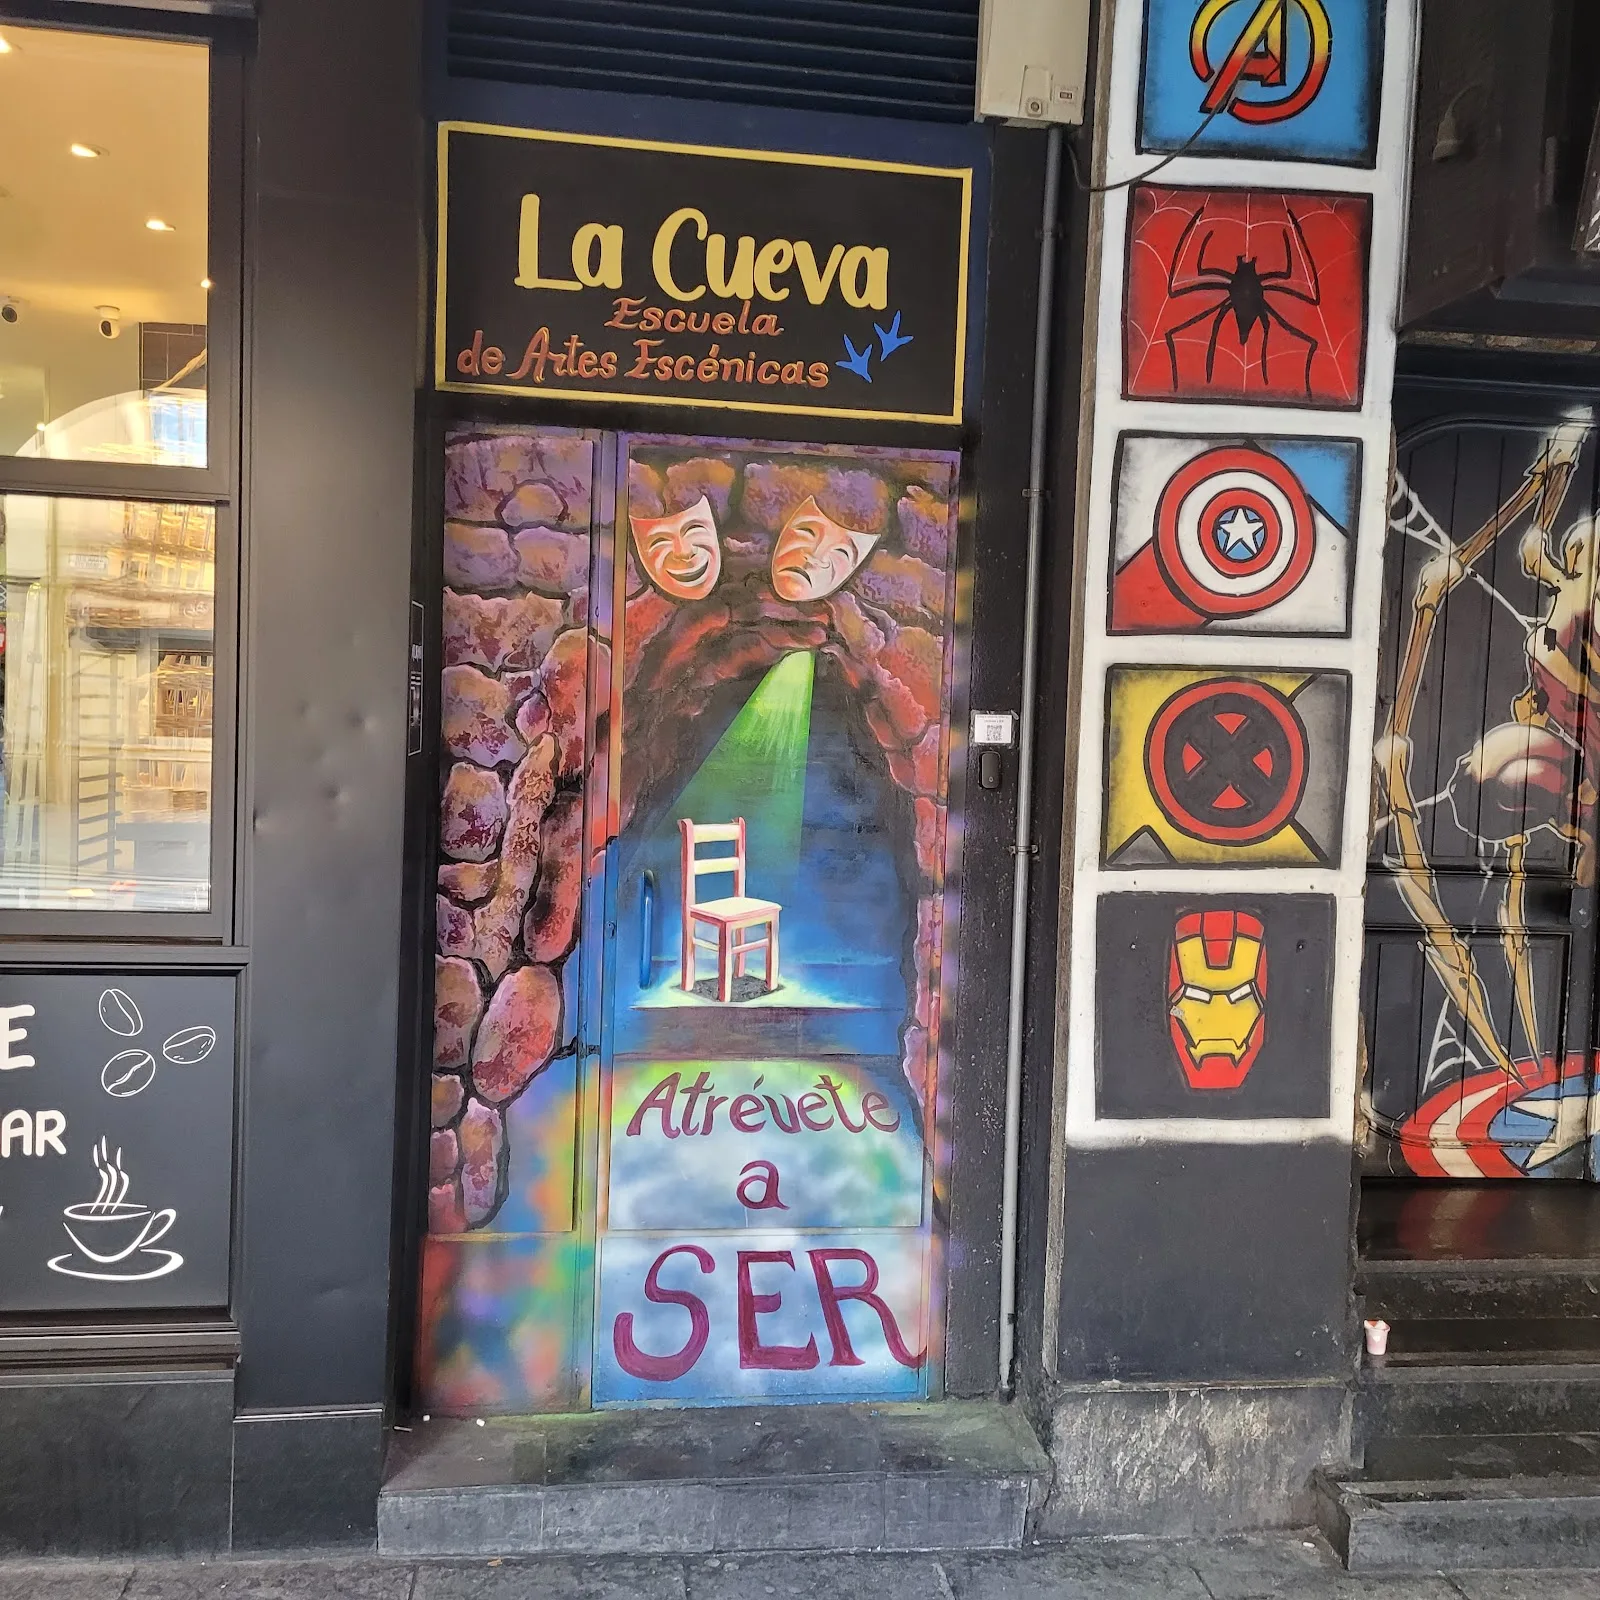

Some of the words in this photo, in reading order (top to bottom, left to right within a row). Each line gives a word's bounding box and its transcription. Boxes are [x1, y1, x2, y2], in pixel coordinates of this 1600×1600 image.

[514, 194, 623, 290] La
[652, 208, 889, 309] Cueva
[605, 297, 784, 336] Escuela
[457, 330, 505, 375] de
[506, 326, 617, 383] Artes
[624, 339, 830, 387] Escénicas
[627, 1072, 901, 1138] Atrévete
[736, 1160, 790, 1210] a
[613, 1245, 928, 1381] SER
